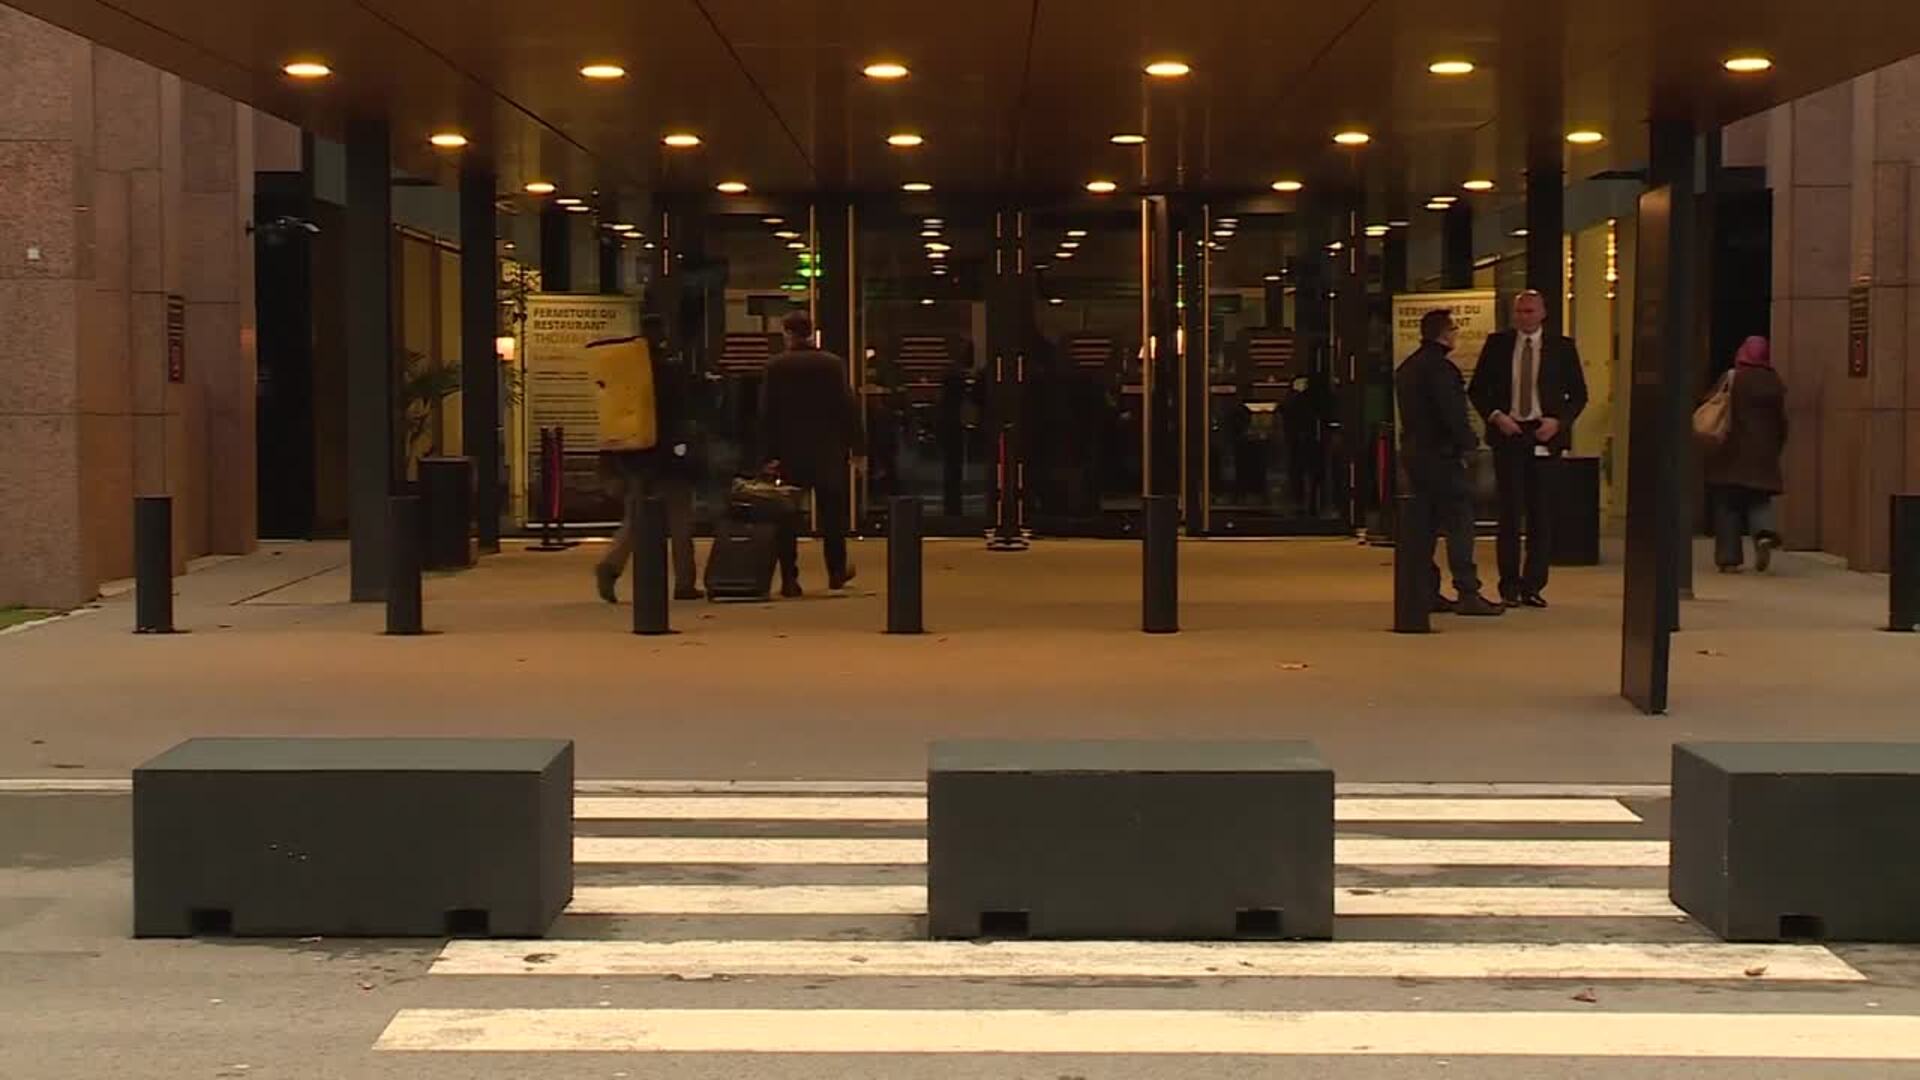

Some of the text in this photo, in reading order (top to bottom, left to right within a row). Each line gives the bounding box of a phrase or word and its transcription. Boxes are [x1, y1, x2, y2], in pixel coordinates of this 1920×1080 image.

[533, 308, 598, 319] FERMETURE
[1464, 305, 1481, 315] DU
[533, 320, 608, 331] RESTAURANT
